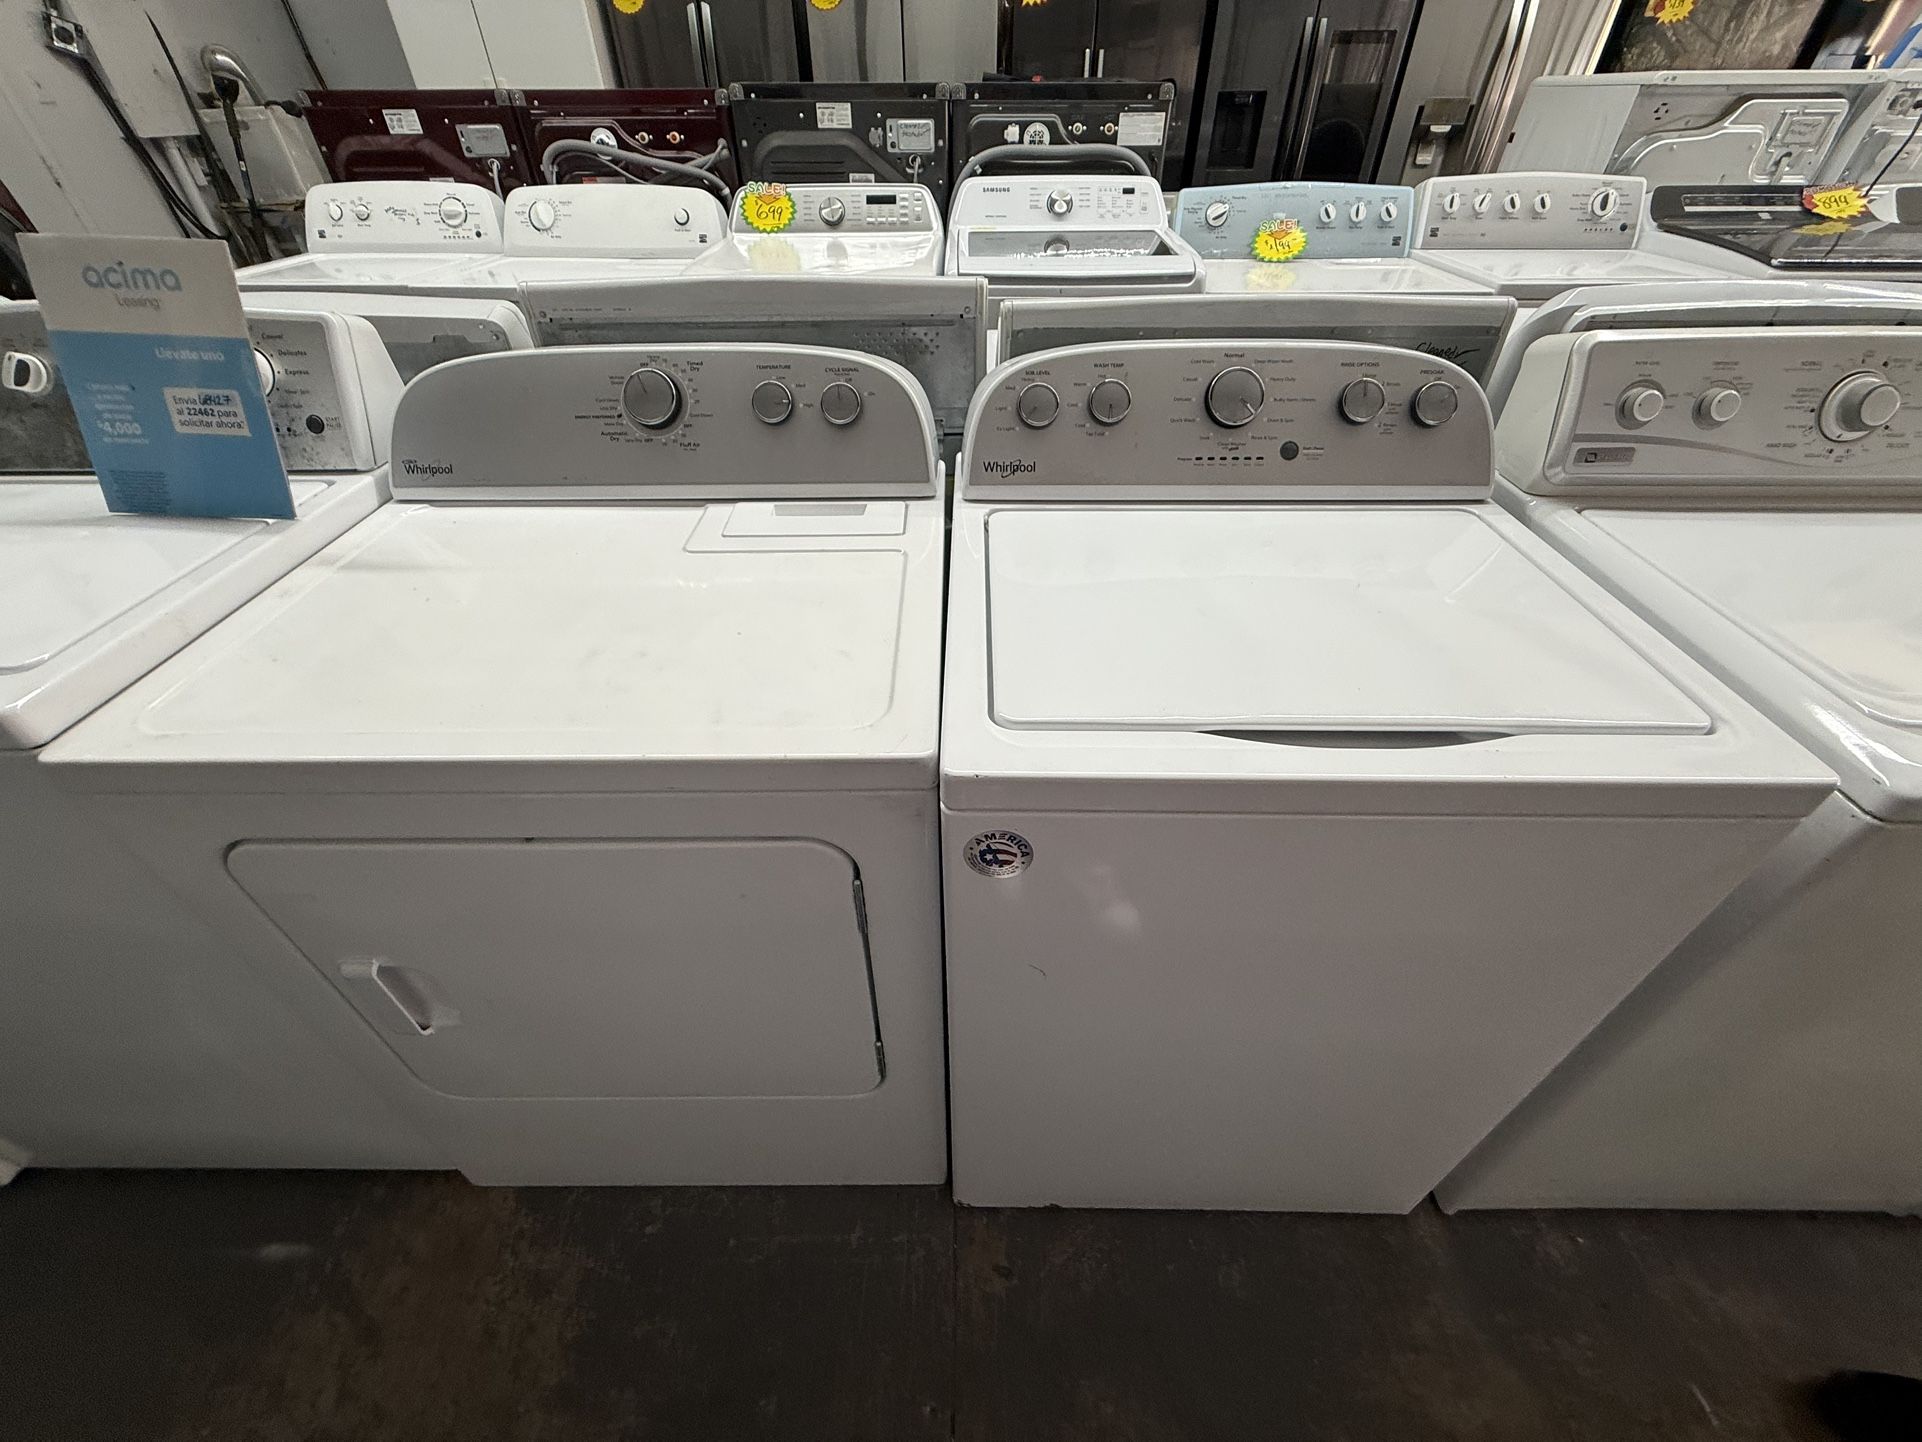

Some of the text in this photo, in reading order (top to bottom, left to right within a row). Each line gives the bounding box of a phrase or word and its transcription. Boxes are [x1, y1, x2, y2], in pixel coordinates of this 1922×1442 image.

[748, 182, 787, 196] SALE!
[1260, 219, 1298, 232] SALE!
[82, 260, 182, 292] acima
[176, 408, 238, 419] al 22462 para
[179, 418, 214, 427] solicitar
[404, 464, 454, 477] Whirlpool
[983, 460, 1036, 476] Whirlpool
[974, 832, 1030, 858] AMERICA
